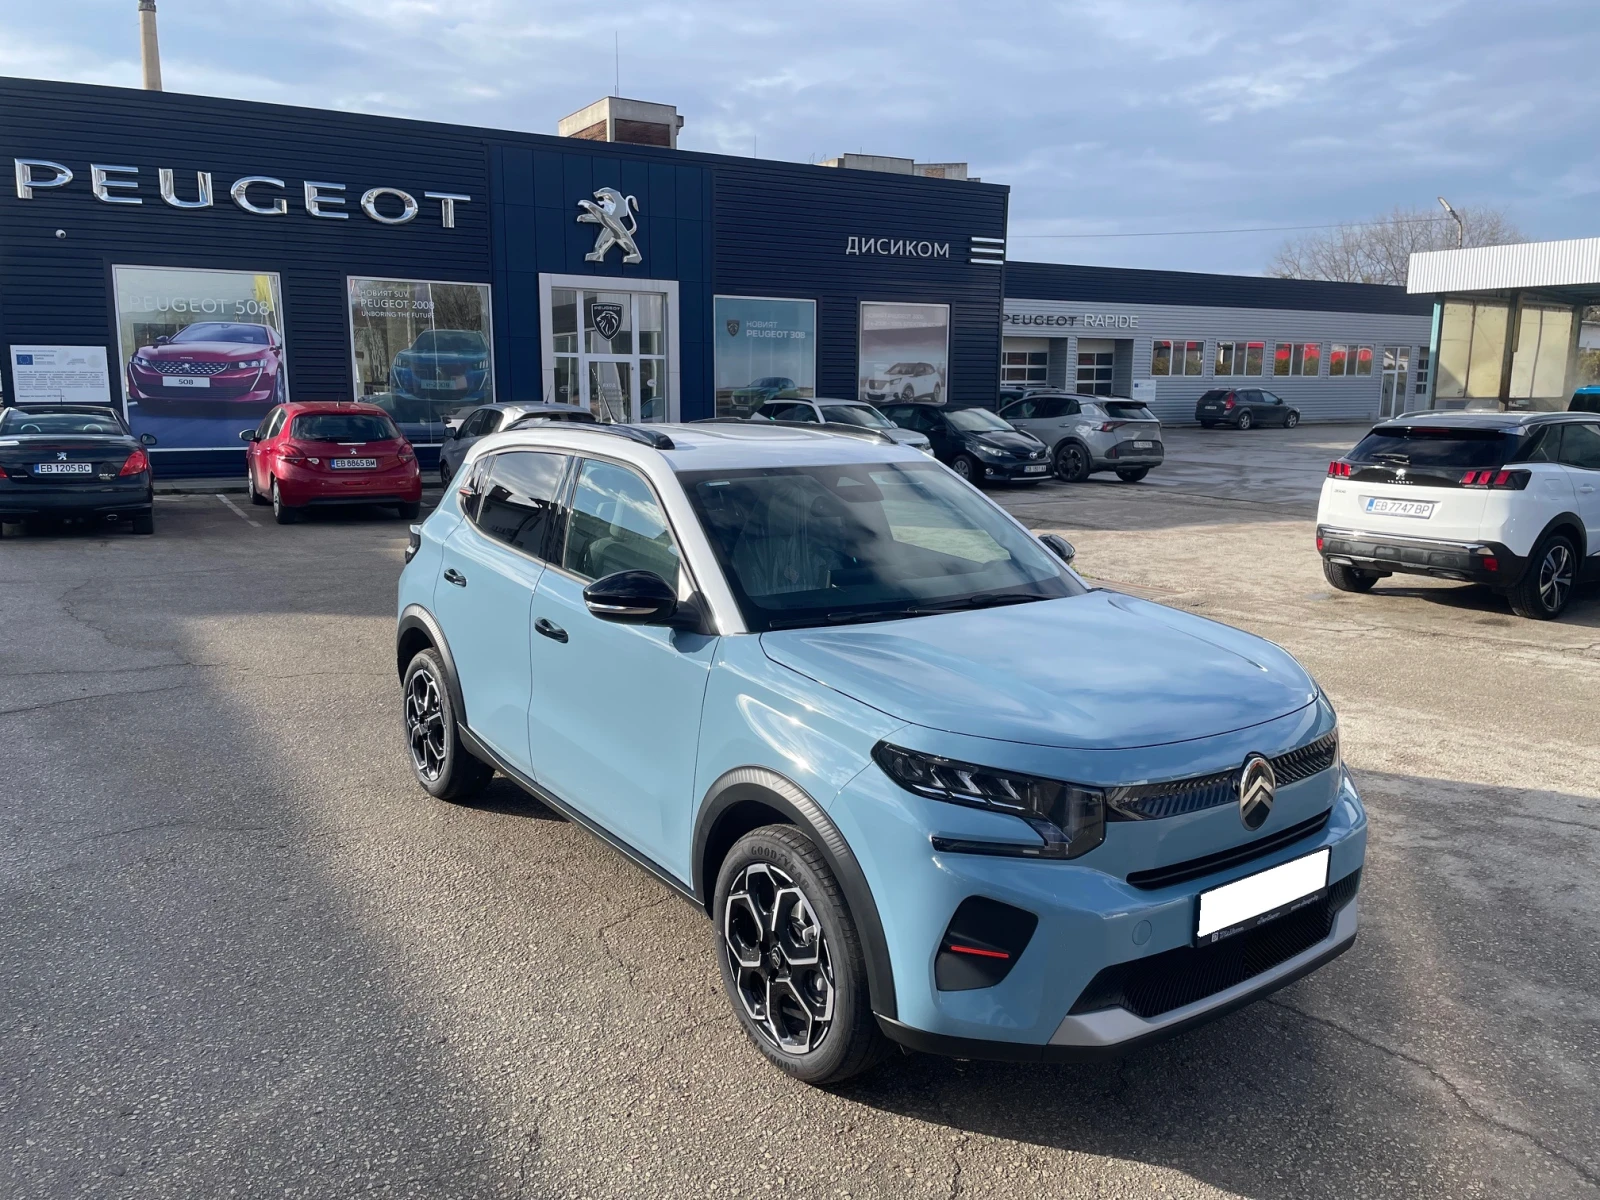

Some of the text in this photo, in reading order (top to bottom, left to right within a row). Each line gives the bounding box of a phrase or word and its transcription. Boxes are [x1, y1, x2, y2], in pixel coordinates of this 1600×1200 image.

[14, 158, 471, 228] PEUGEOT
[846, 236, 949, 258] ДИСИКОМ
[129, 295, 270, 316] PEUGEOT 508
[360, 299, 435, 310] PEUGEOT 2008
[746, 320, 778, 328] НОВИЯТ
[1083, 314, 1139, 328] RAPIDE
[746, 329, 806, 339] PEUGEOT 308
[40, 464, 91, 472] EB 1205 BC
[1374, 501, 1430, 514] EB 7747 BP
[751, 846, 810, 890] GOODYEAR
